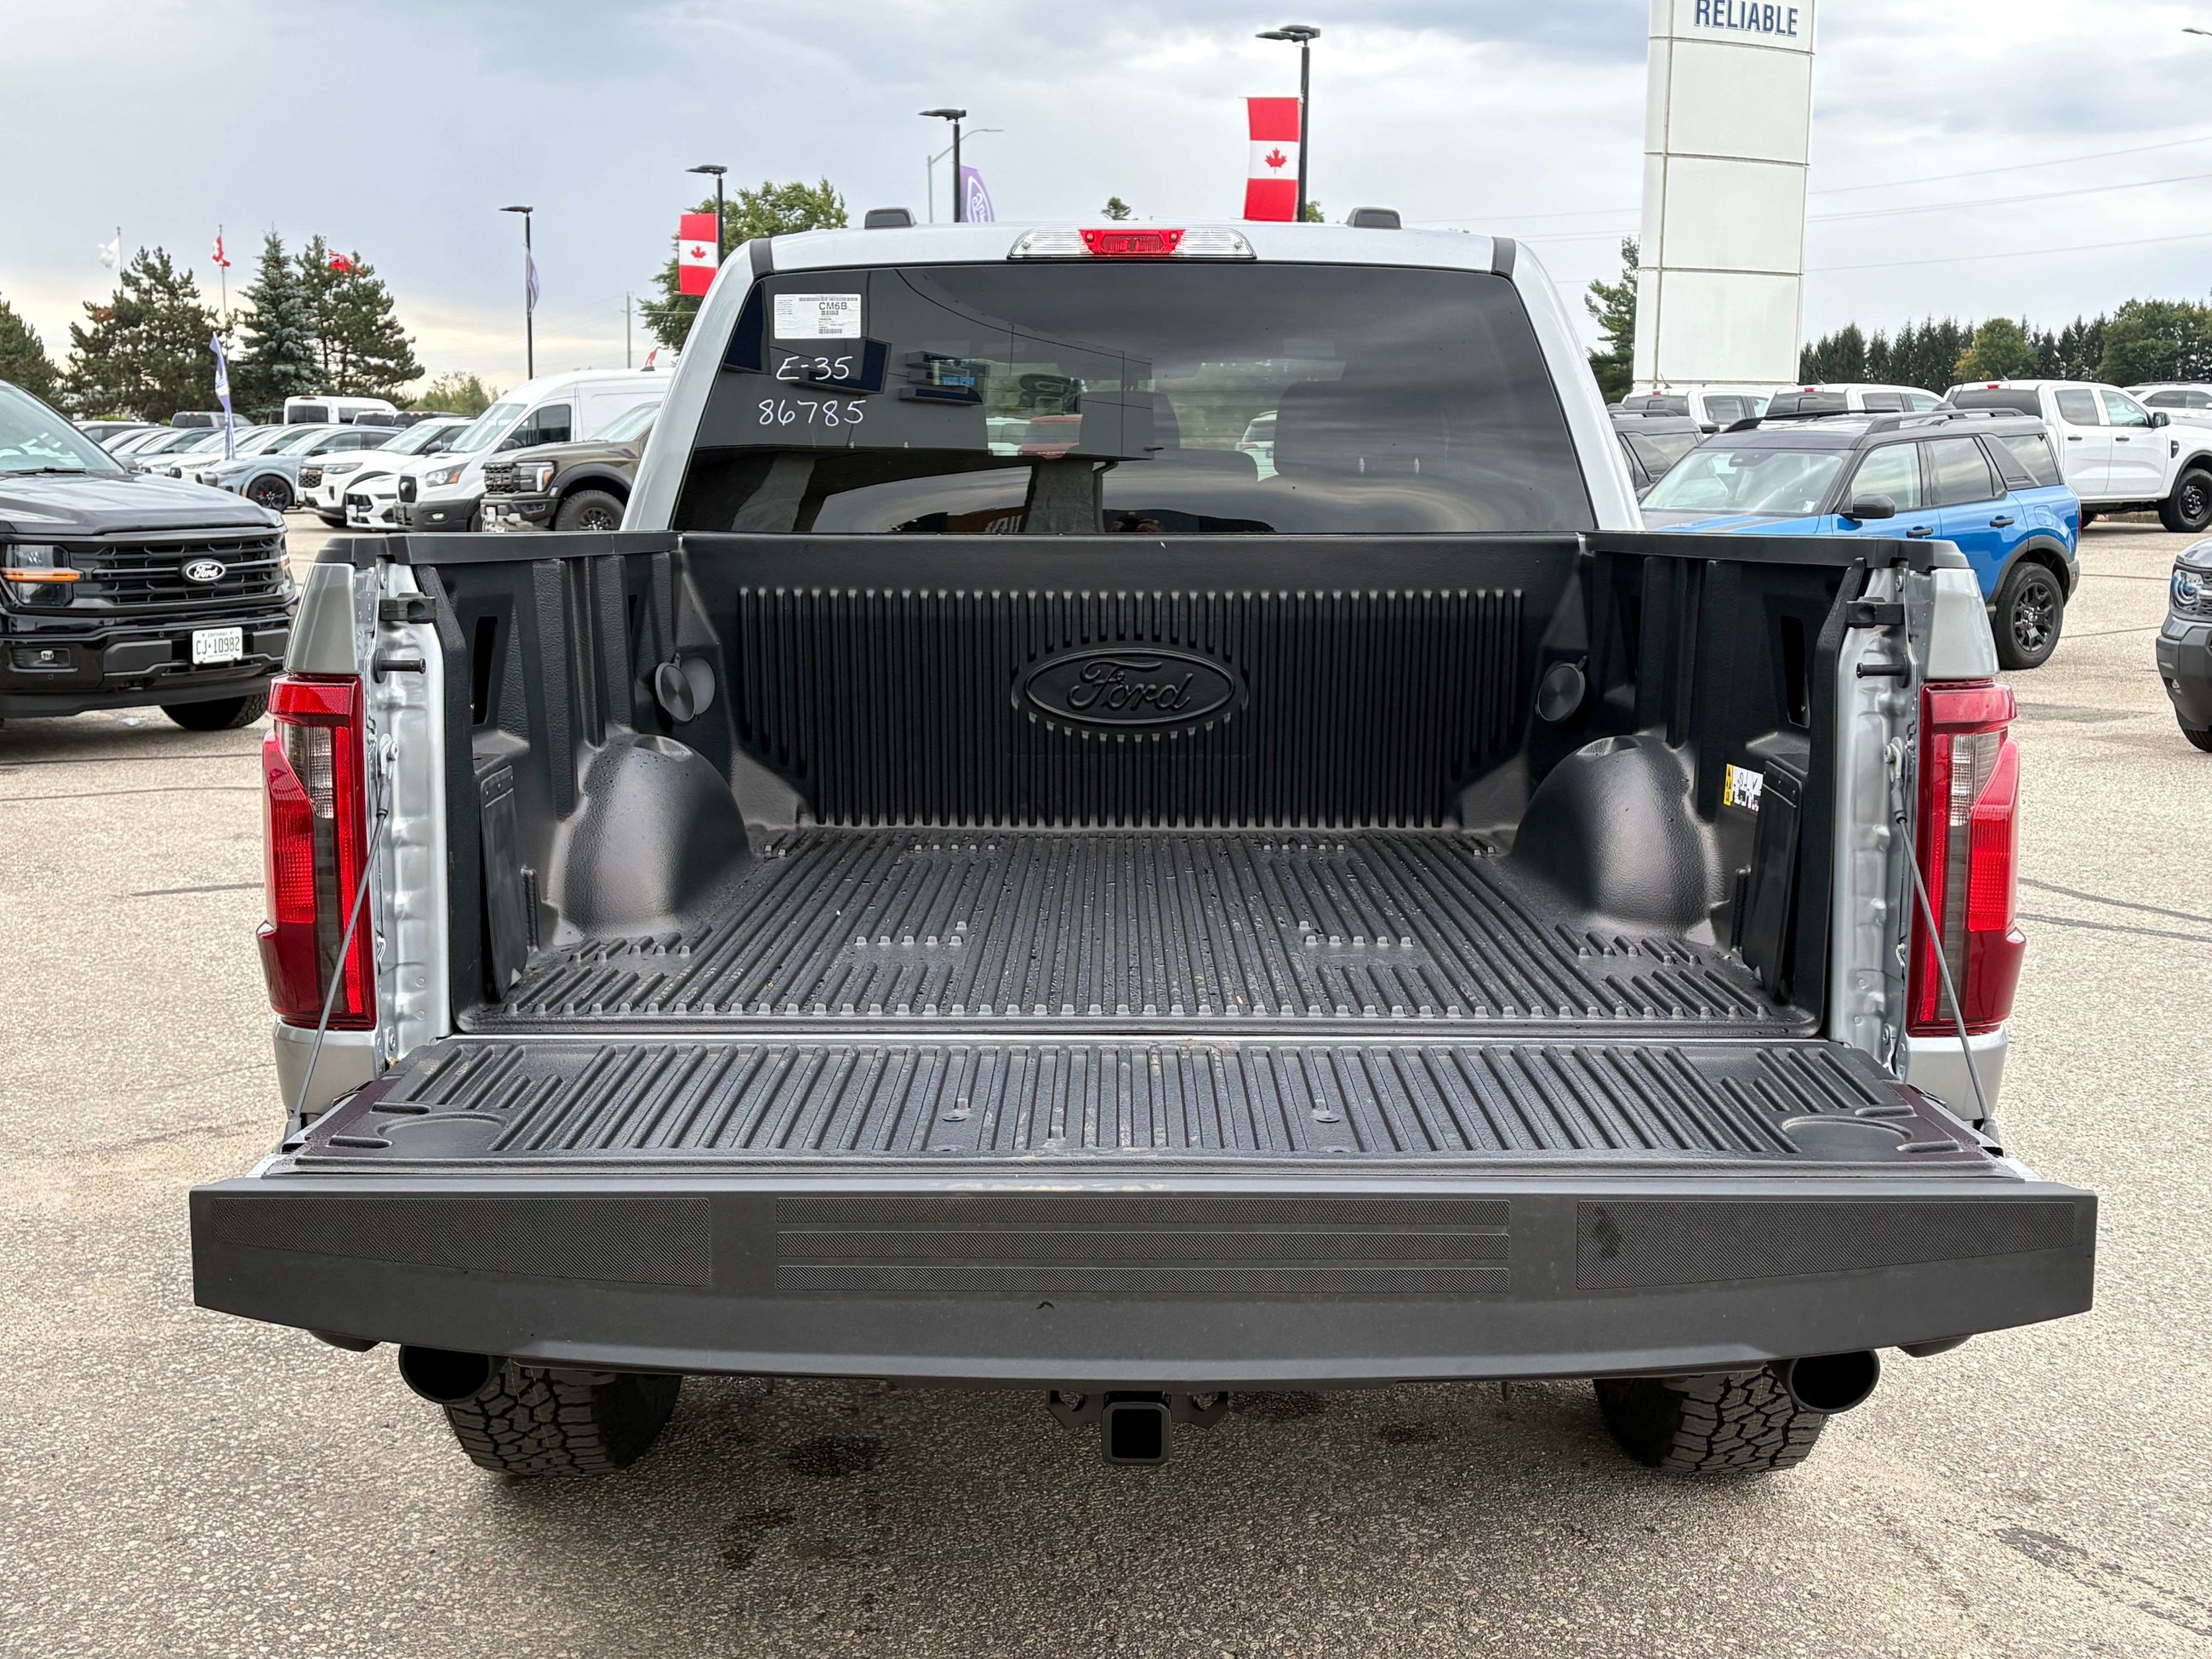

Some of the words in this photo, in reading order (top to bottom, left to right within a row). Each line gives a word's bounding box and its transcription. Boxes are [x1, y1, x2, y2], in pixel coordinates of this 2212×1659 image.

[1695, 0, 1798, 37] RELIABLE
[818, 301, 847, 311] CM6B
[775, 356, 853, 380] E-35
[758, 398, 867, 426] 86785
[193, 564, 219, 579] Ford
[1067, 658, 1194, 710] Ford
